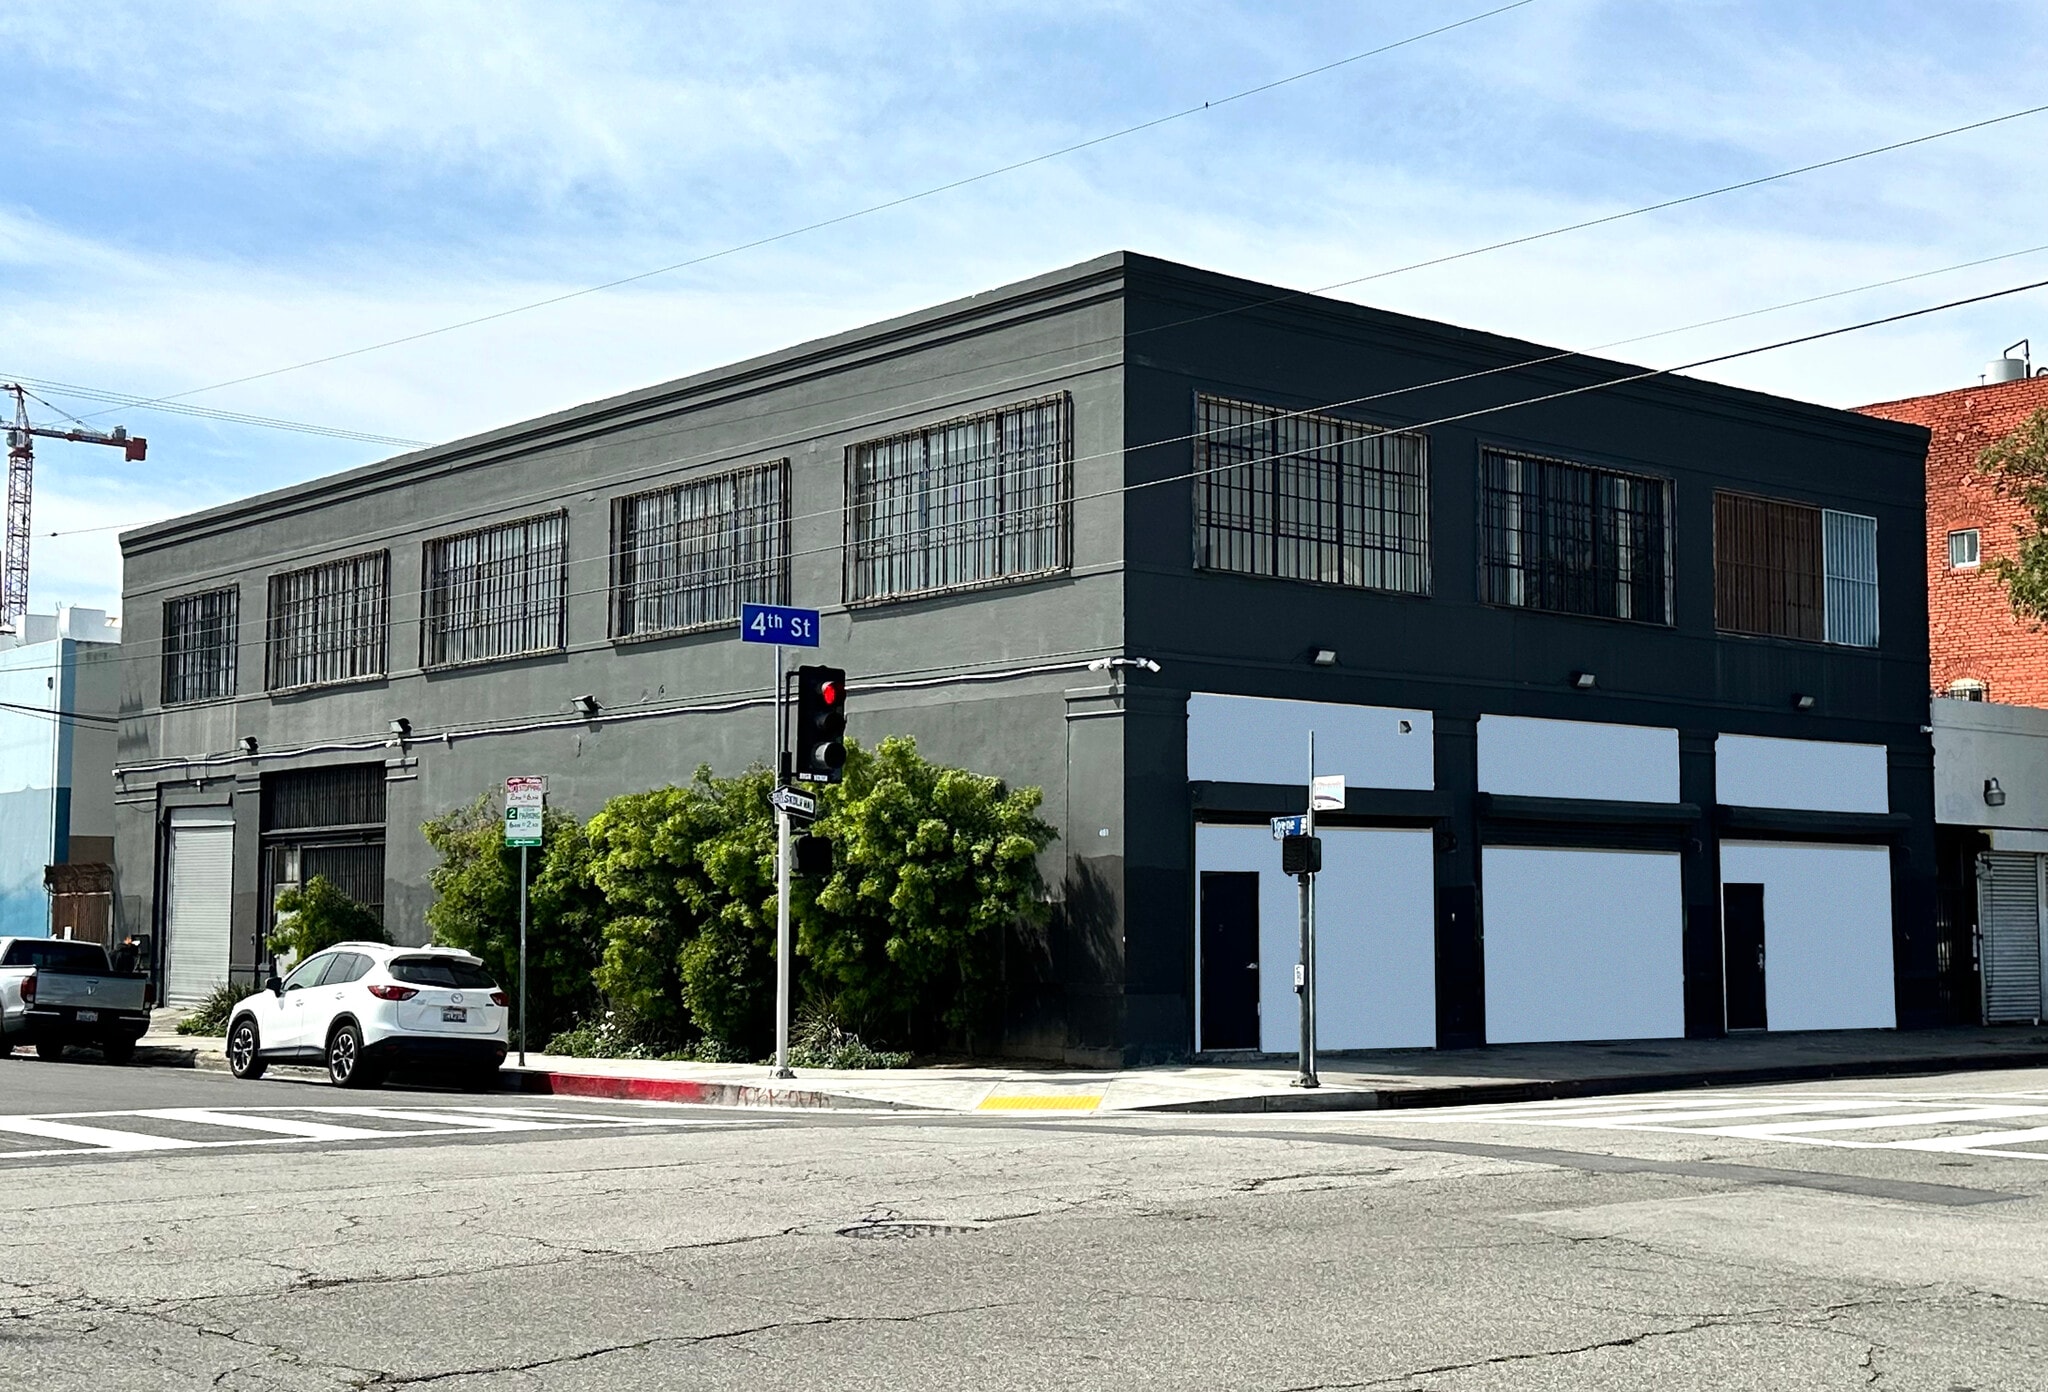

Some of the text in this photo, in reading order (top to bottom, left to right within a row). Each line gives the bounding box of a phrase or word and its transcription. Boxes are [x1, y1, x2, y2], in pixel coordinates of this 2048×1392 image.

[750, 612, 811, 638] 4th St
[509, 809, 516, 819] 2
